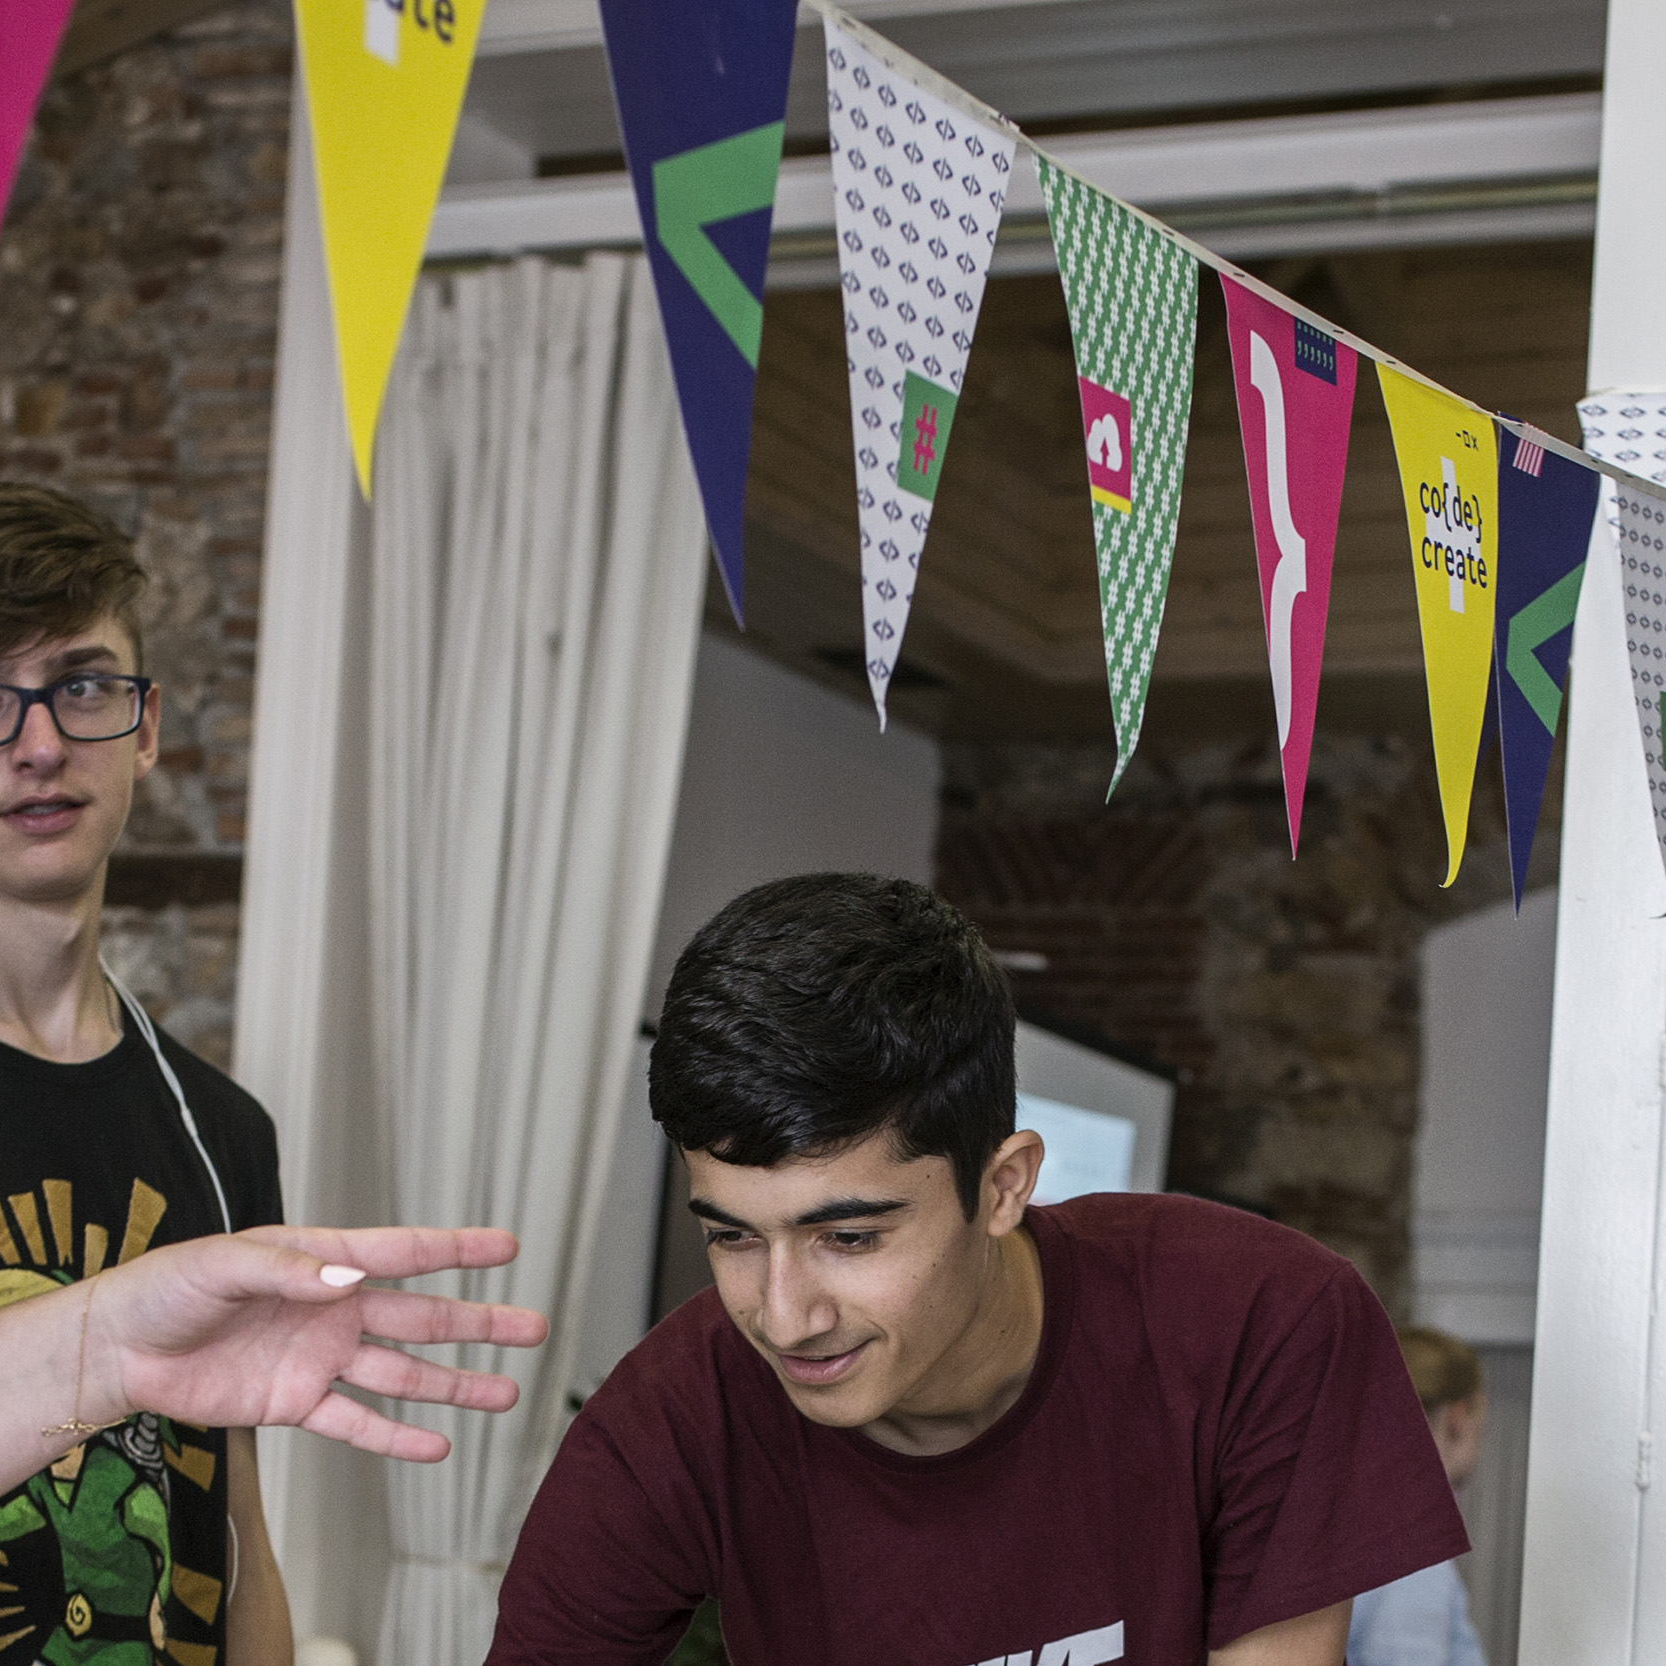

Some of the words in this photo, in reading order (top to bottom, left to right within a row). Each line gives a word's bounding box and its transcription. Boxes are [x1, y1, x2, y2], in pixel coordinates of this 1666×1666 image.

[385, 0, 455, 44] te
[1420, 482, 1483, 544] co{de}
[1422, 536, 1487, 588] create
